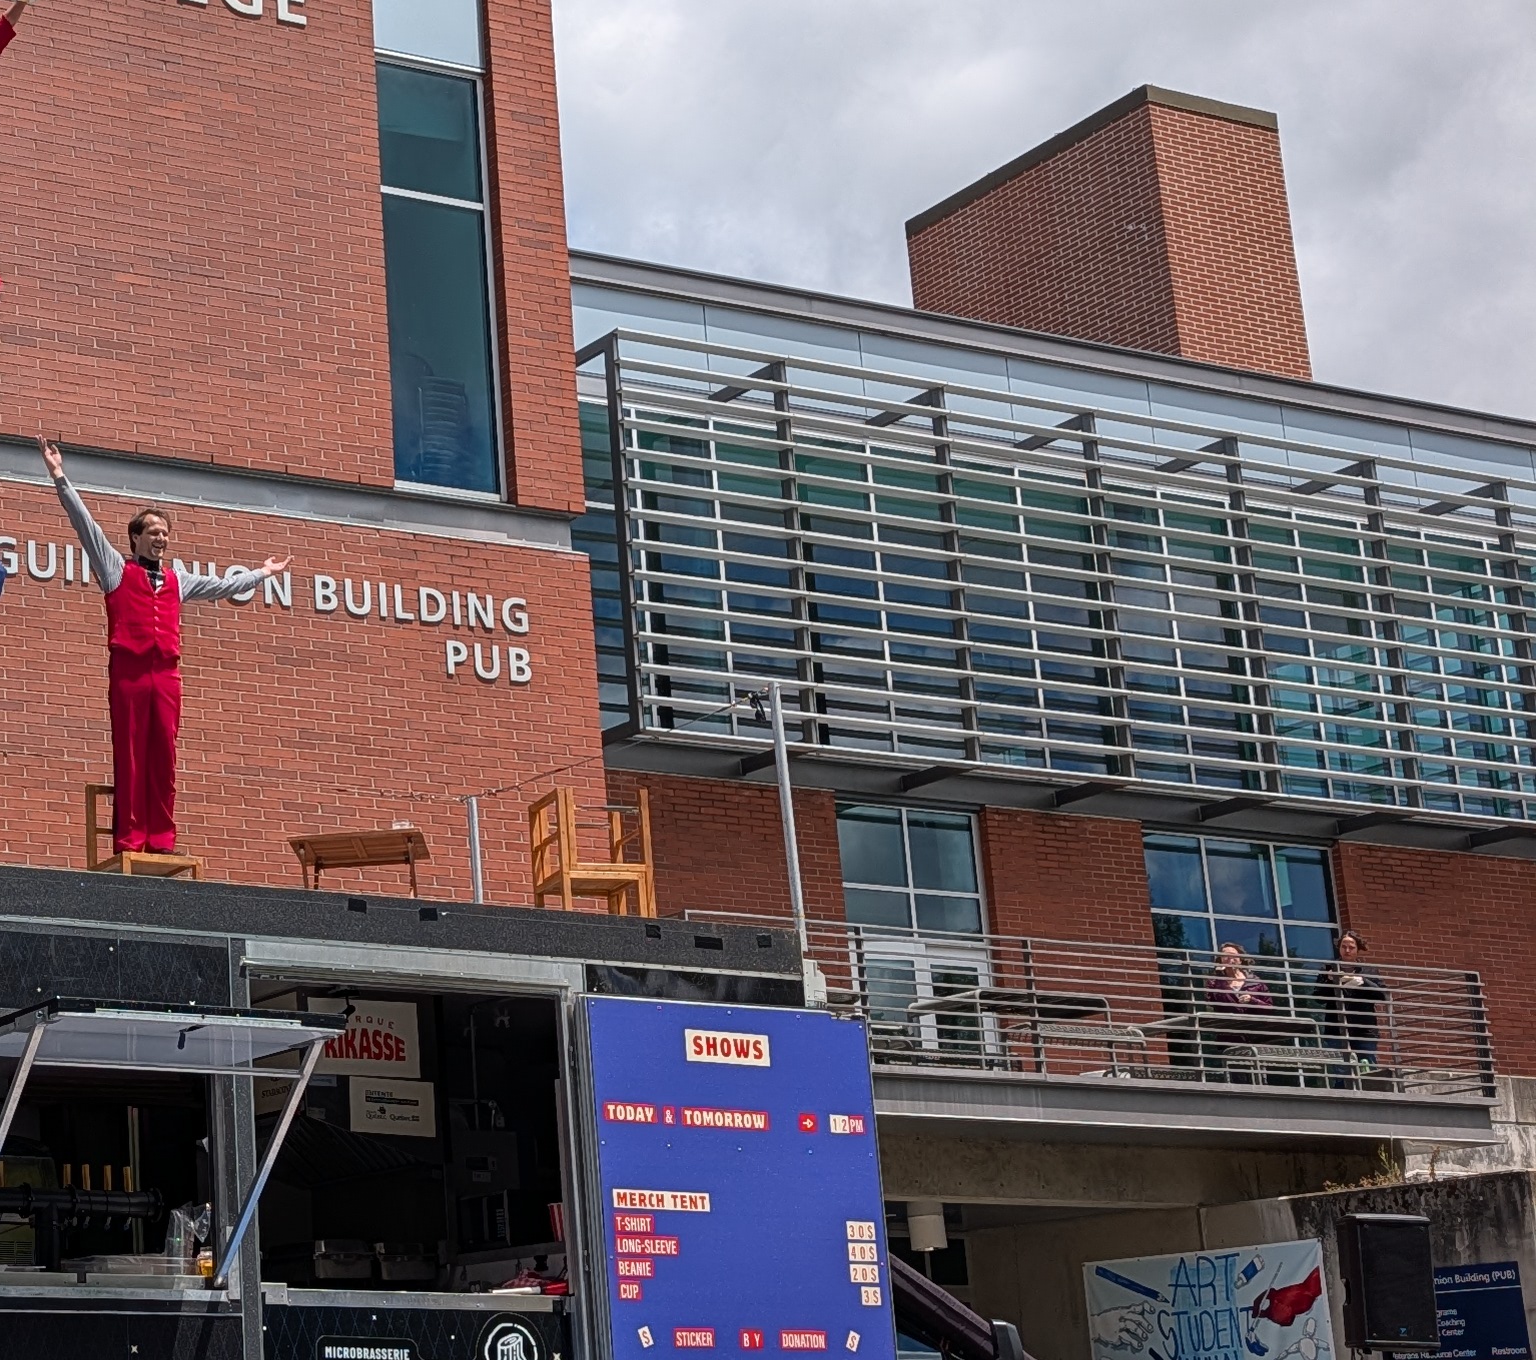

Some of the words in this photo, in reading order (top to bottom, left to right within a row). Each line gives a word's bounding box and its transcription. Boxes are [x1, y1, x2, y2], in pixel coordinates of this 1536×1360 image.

[316, 574, 530, 634] BUILDING
[446, 639, 532, 683] PUB
[345, 1015, 395, 1029] RQUE
[324, 1028, 406, 1061] KIKASSE
[692, 1035, 764, 1059] SHOWS
[607, 1104, 654, 1122] TODAY
[665, 1110, 674, 1123] &
[684, 1110, 765, 1129] TOMORROW
[616, 1192, 665, 1208] MERCH
[671, 1194, 707, 1209] TENT
[615, 1216, 651, 1232] T-SHIRT
[849, 1225, 874, 1239] 30$
[617, 1238, 678, 1255] LONG-SLEEVE
[851, 1246, 876, 1260] 40$
[618, 1260, 652, 1276] BEANIE
[852, 1267, 877, 1281] 20$
[1168, 1253, 1240, 1307] ART
[1455, 1273, 1490, 1284] Building
[1492, 1269, 1516, 1282] (PUB)
[620, 1283, 639, 1299] CUP
[864, 1289, 879, 1304] 3$
[641, 1330, 651, 1345] $
[675, 1330, 713, 1347] STICKER
[743, 1332, 761, 1348] BY
[781, 1332, 826, 1349] DONATION
[849, 1333, 858, 1349] $
[1157, 1305, 1255, 1360] STUDENT
[324, 1346, 410, 1360] MICROBRASSERIE
